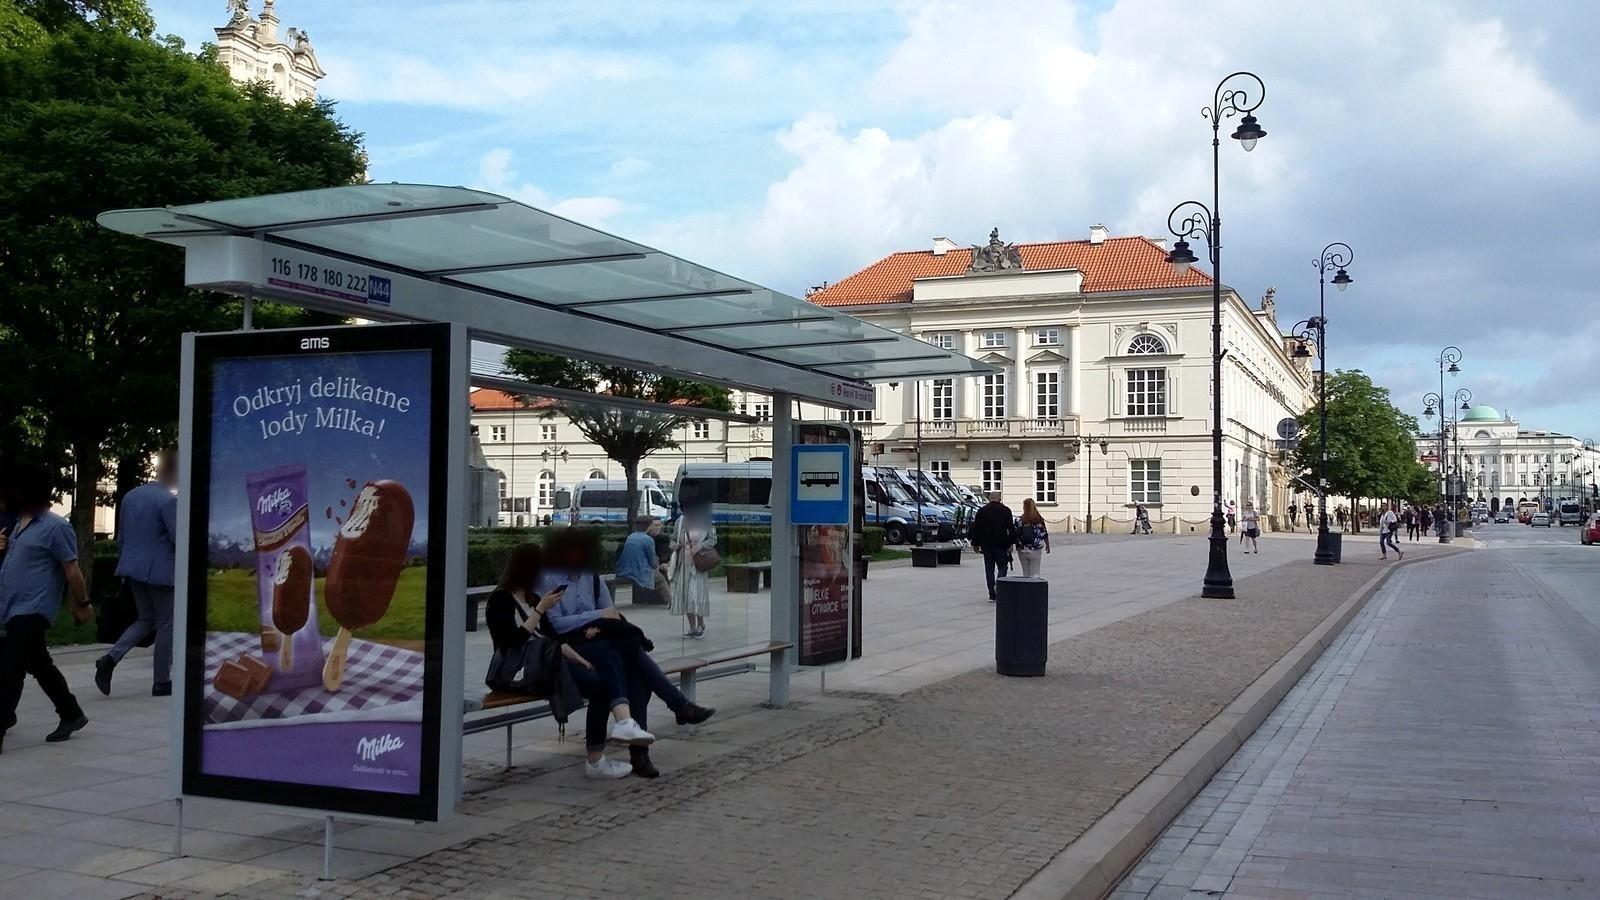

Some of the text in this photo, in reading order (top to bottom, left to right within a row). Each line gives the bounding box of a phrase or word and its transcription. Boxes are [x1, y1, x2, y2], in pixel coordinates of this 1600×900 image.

[272, 258, 391, 299] 116 178 180 222 N44
[300, 336, 330, 350] ams
[233, 376, 411, 417] Odkryj delikatne
[260, 406, 386, 440] lody Milka!
[257, 487, 292, 515] Milka
[356, 733, 404, 761] Milka
